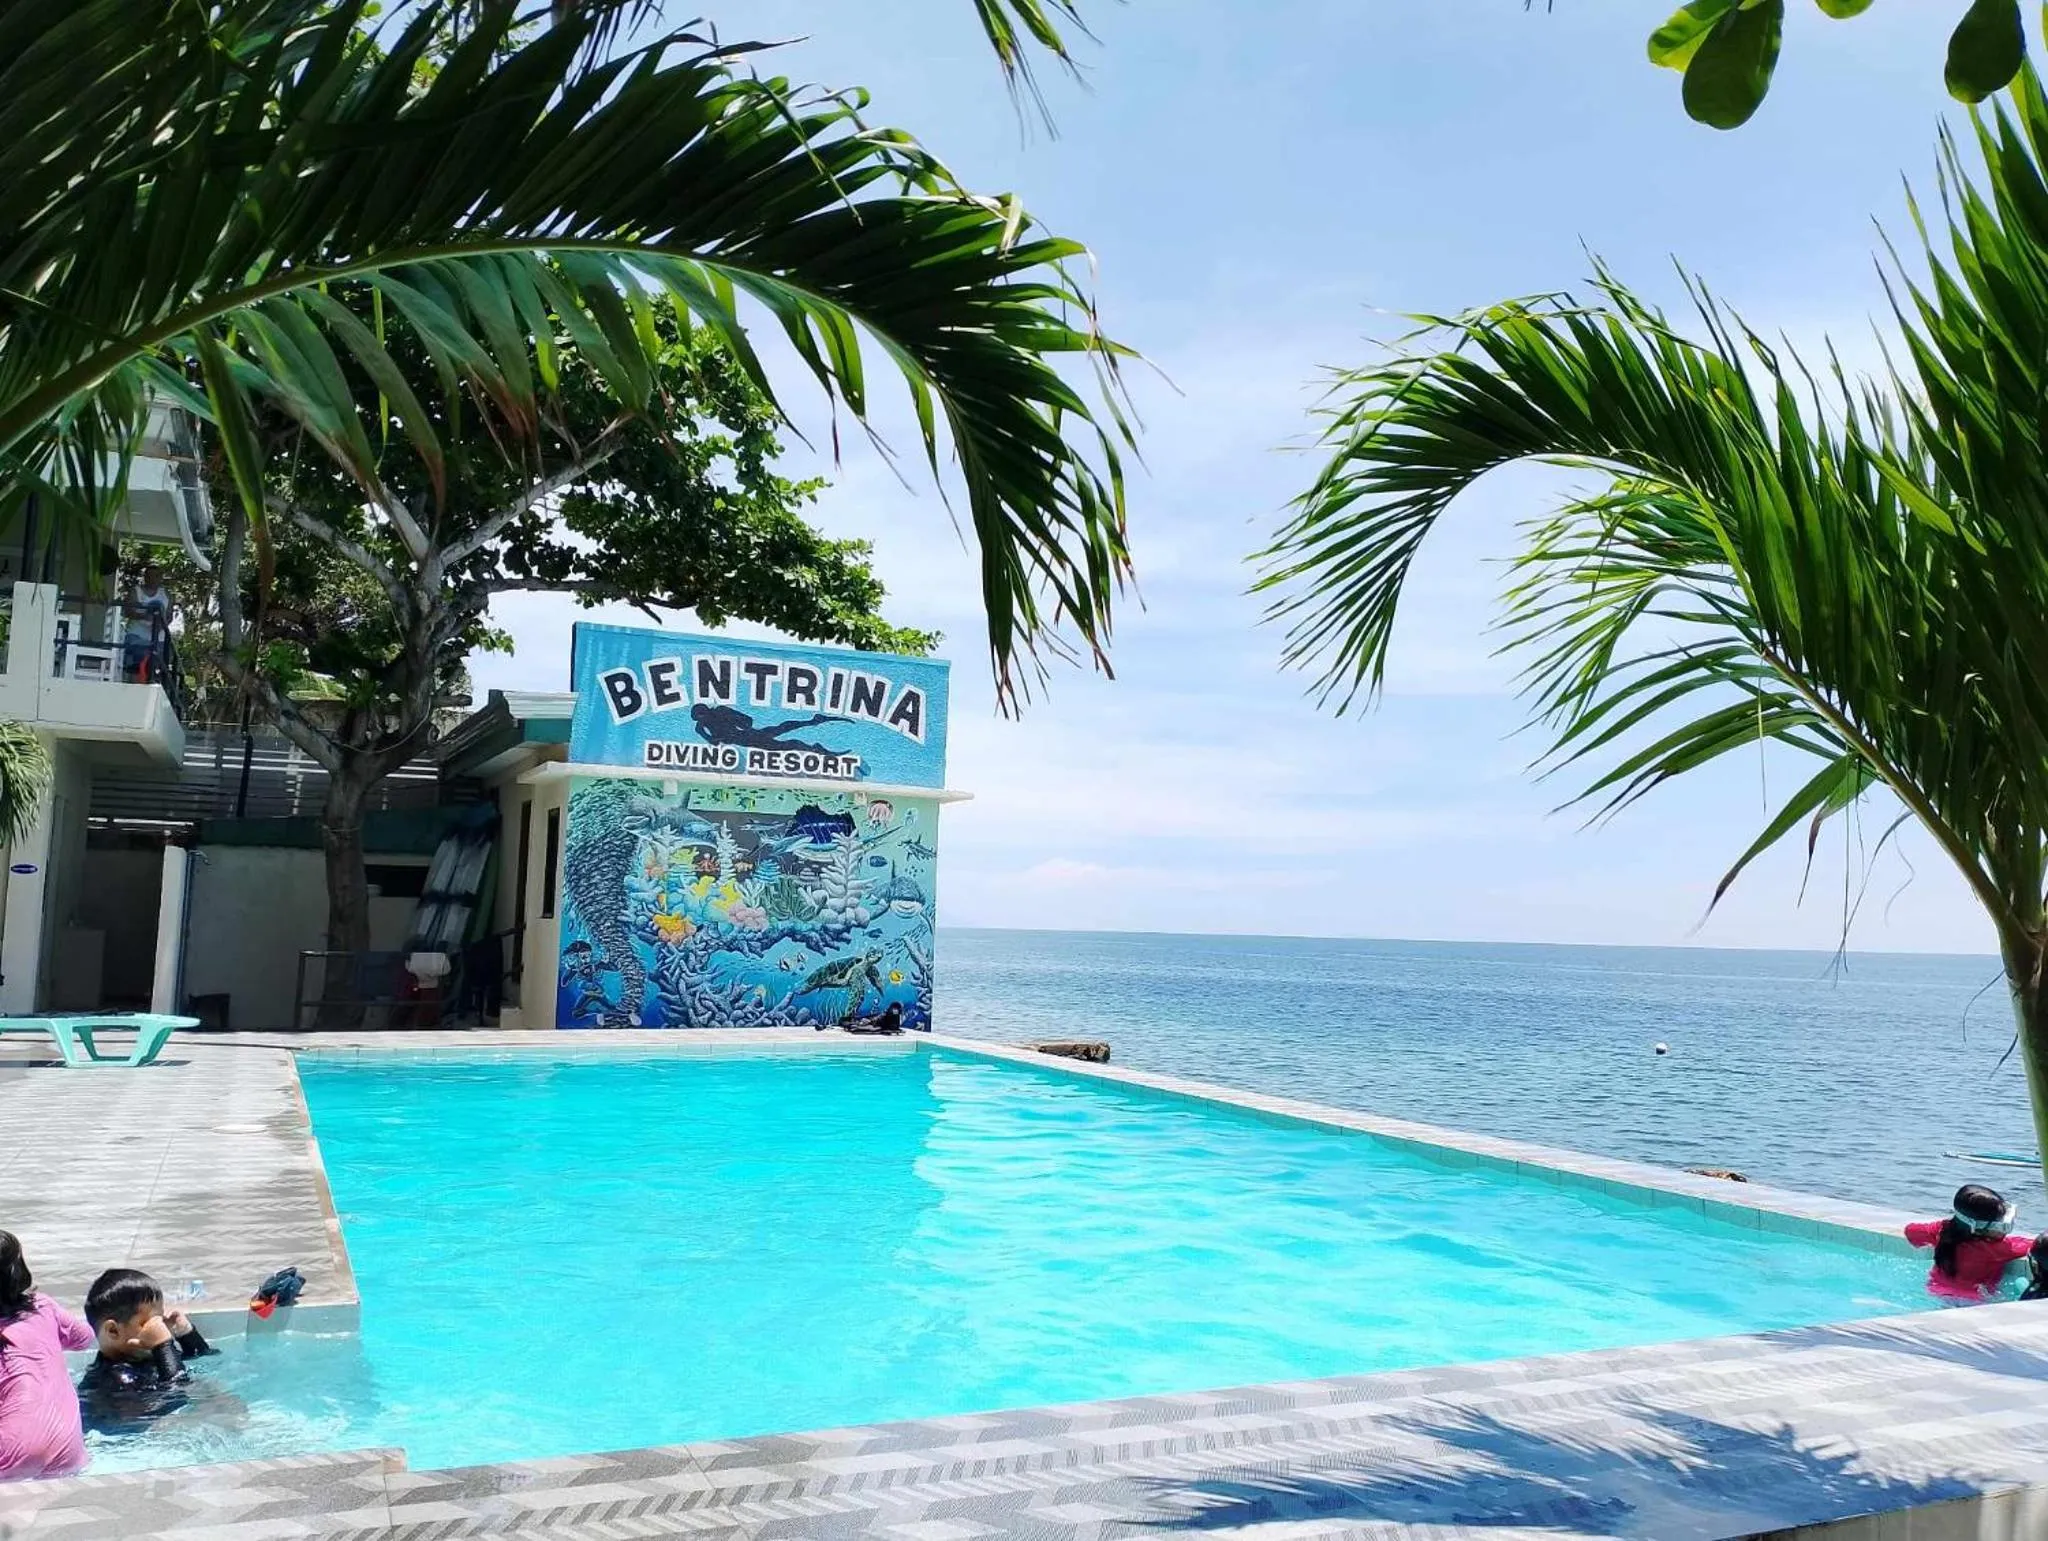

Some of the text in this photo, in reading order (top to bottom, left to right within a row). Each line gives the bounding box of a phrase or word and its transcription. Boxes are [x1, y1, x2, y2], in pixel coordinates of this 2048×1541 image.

[600, 656, 925, 741] BENTRINA
[646, 742, 859, 777] DIVING RESORT
